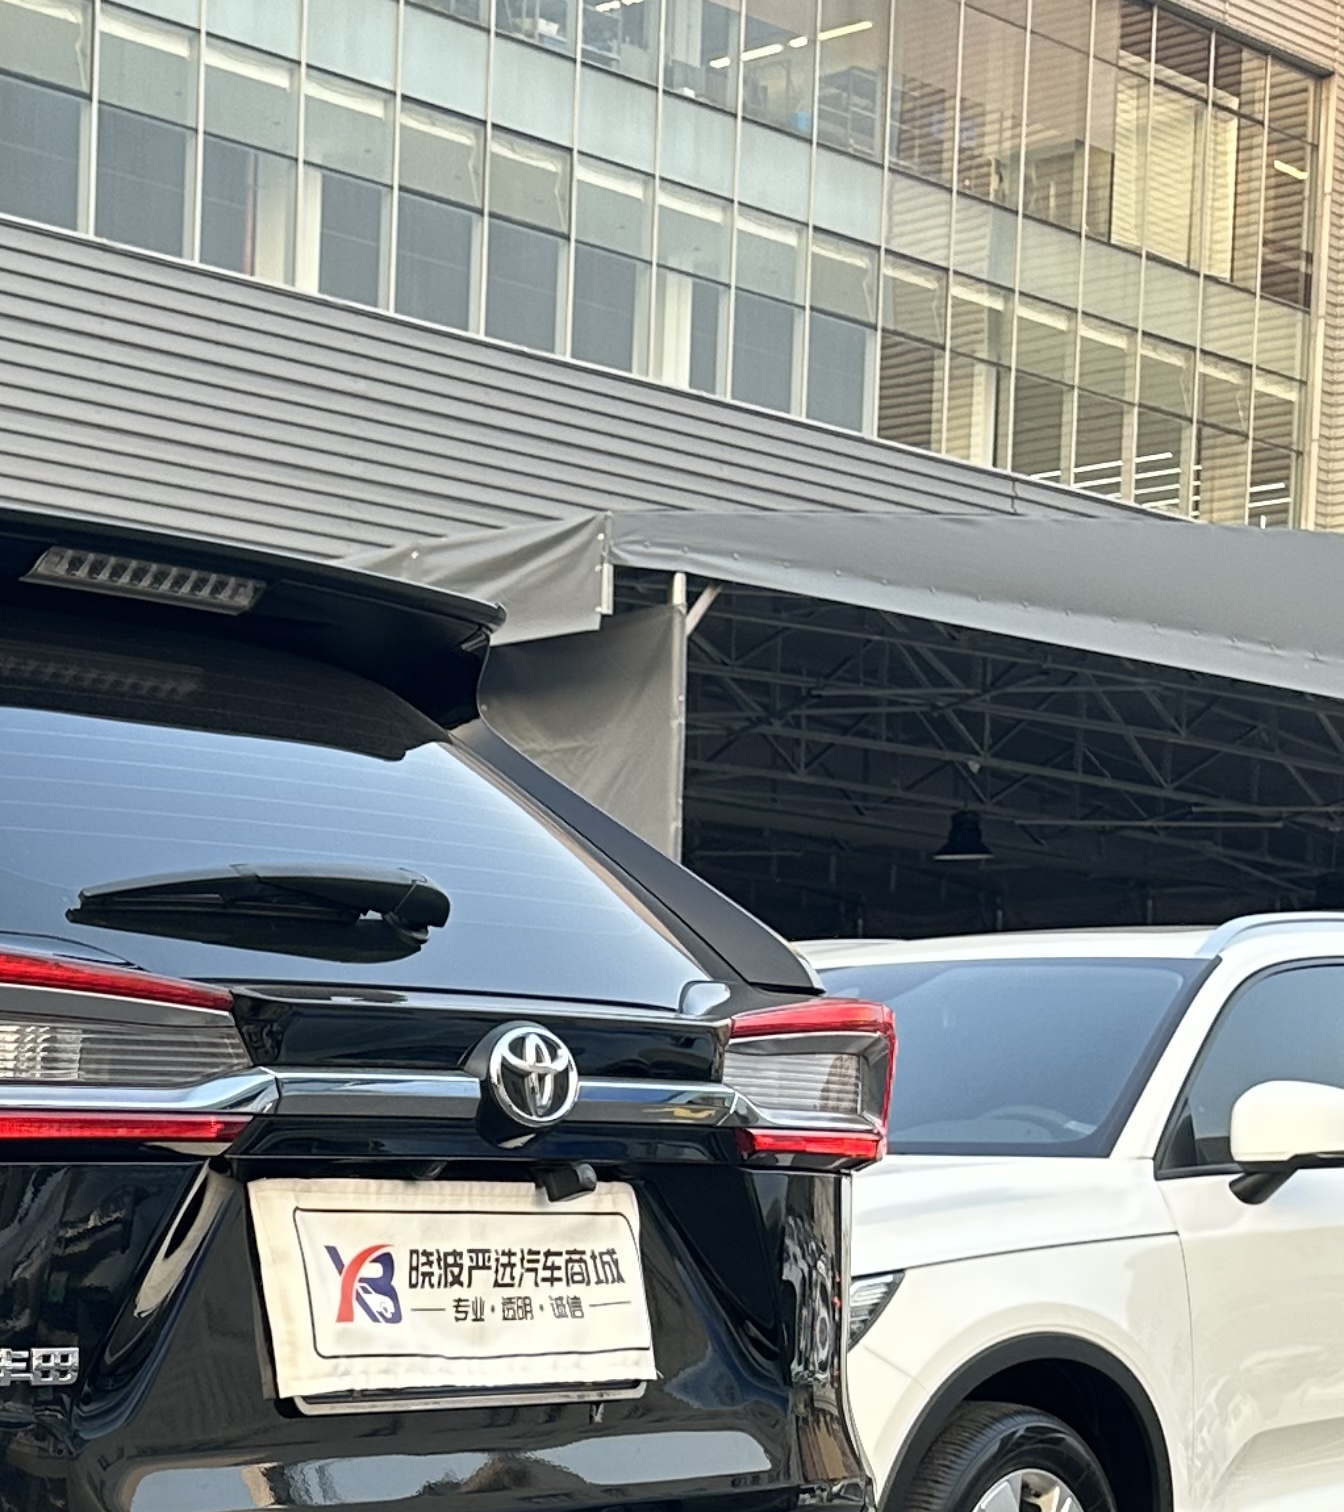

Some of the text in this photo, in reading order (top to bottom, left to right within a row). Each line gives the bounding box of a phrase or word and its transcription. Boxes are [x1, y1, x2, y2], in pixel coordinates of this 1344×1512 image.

[408, 1247, 626, 1290] 晓波严选汽车商城
